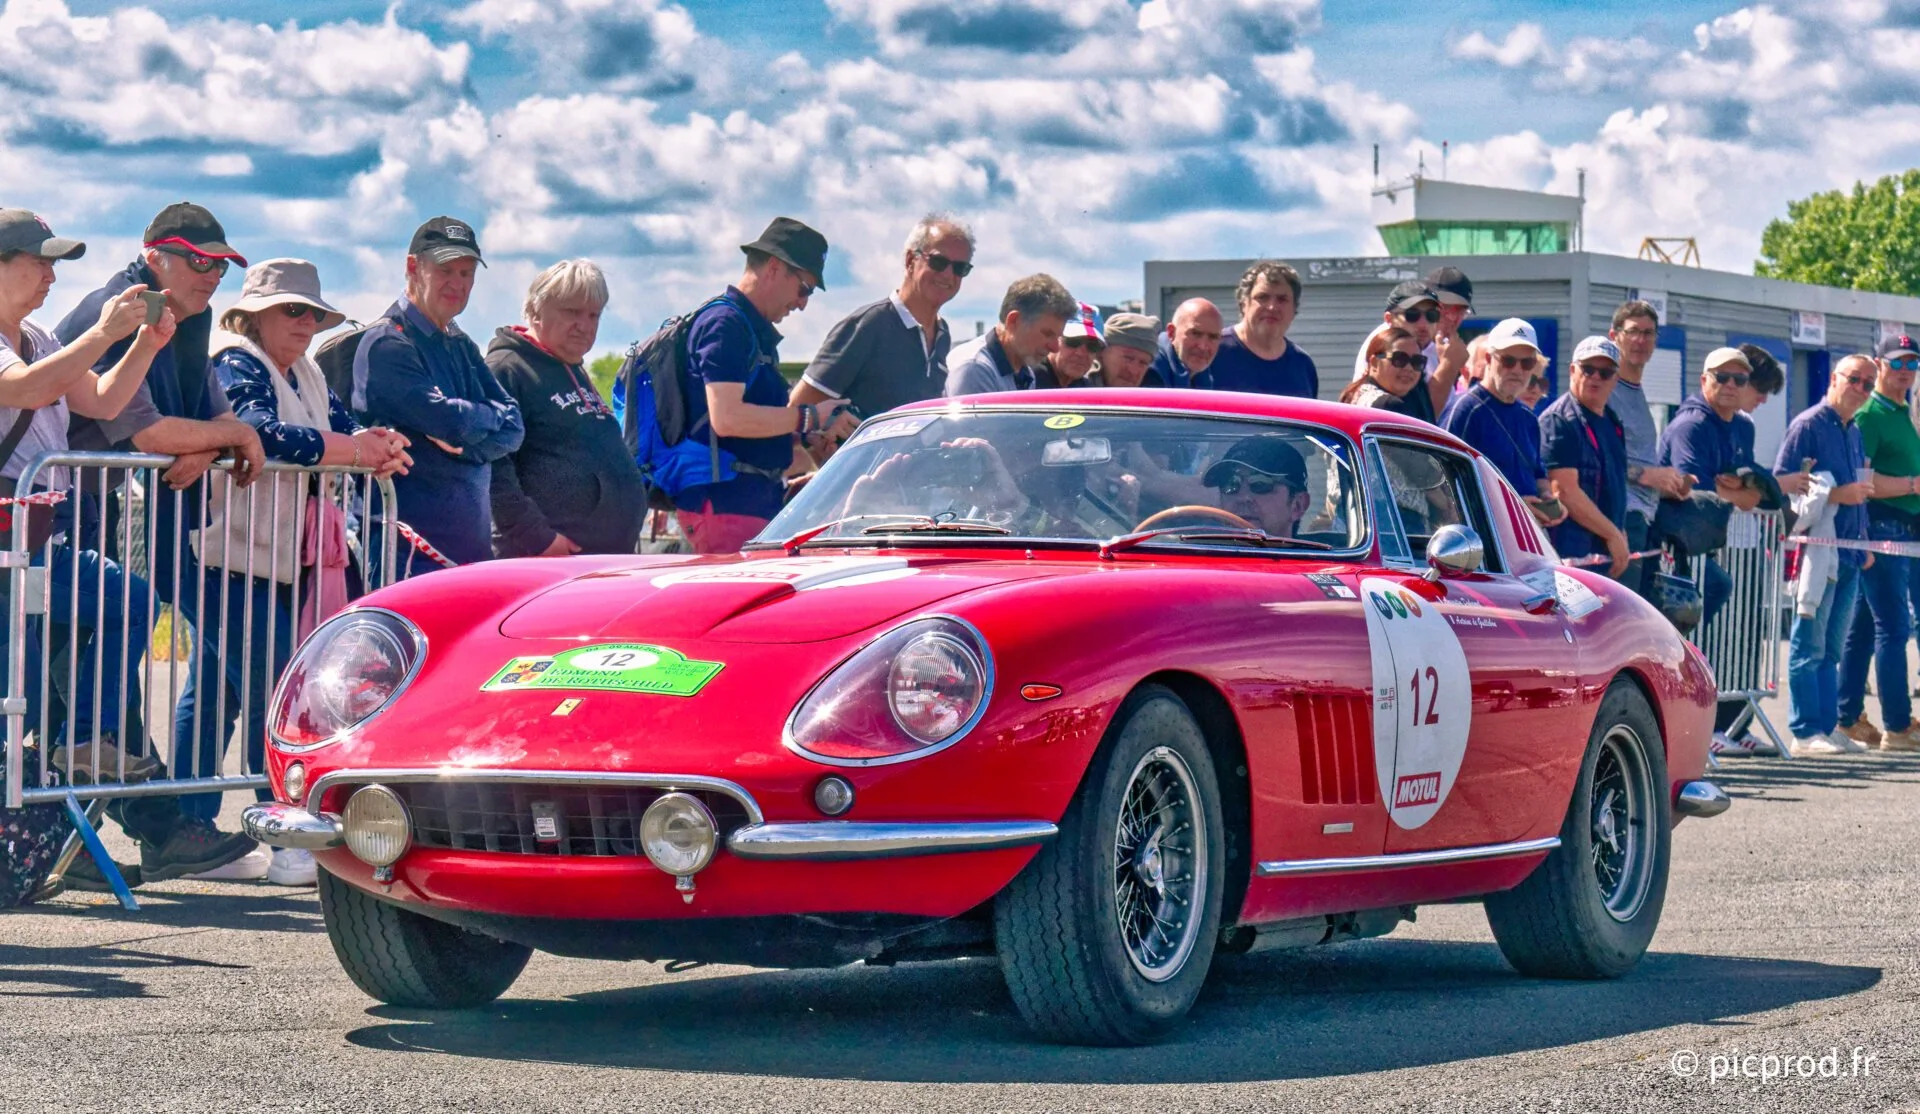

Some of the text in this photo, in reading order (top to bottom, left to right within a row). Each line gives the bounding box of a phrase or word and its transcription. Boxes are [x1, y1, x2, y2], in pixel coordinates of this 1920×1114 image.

[550, 391, 581, 410] Los
[1054, 417, 1071, 427] B
[600, 652, 636, 667] 12
[550, 668, 623, 677] EDMOND
[567, 677, 674, 689] ROTHSCHILD
[1410, 666, 1439, 727] 12
[1397, 776, 1439, 804] MOTUL
